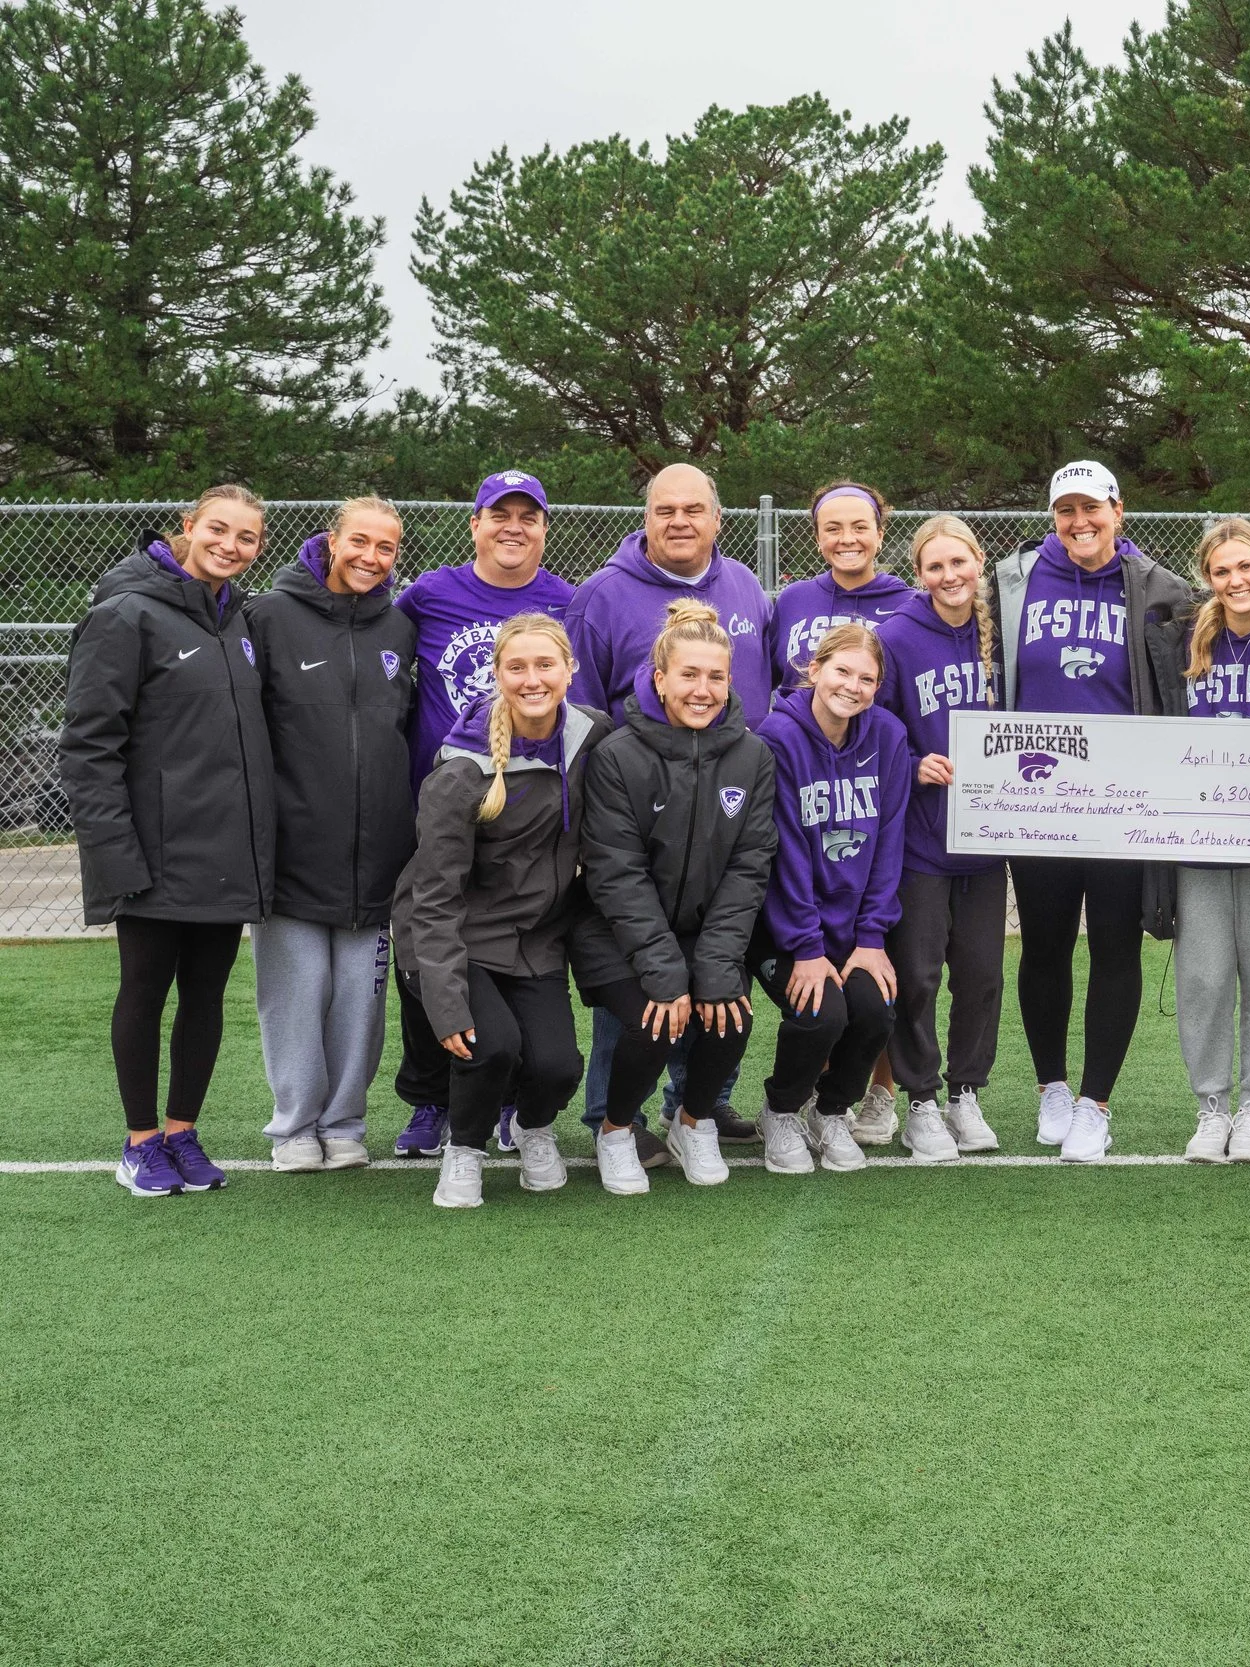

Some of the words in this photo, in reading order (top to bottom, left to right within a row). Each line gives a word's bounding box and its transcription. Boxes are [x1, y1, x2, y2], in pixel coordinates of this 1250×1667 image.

[1056, 467, 1093, 484] K-STATE
[990, 722, 1083, 736] MANHATTAN
[983, 734, 1090, 762] CATBACKERS
[1180, 746, 1214, 768] April
[1222, 751, 1235, 768] 11,
[1000, 779, 1045, 795] Kansas
[1056, 781, 1096, 796] State
[1104, 783, 1149, 798] Soccer
[1199, 791, 1207, 801] $
[969, 796, 992, 811] Six
[993, 797, 1040, 813] thousand
[1039, 802, 1058, 814] and
[1059, 801, 1085, 814] three
[1085, 802, 1125, 815] hundred
[979, 825, 1015, 842] Superb
[1123, 828, 1185, 845] Manhattan
